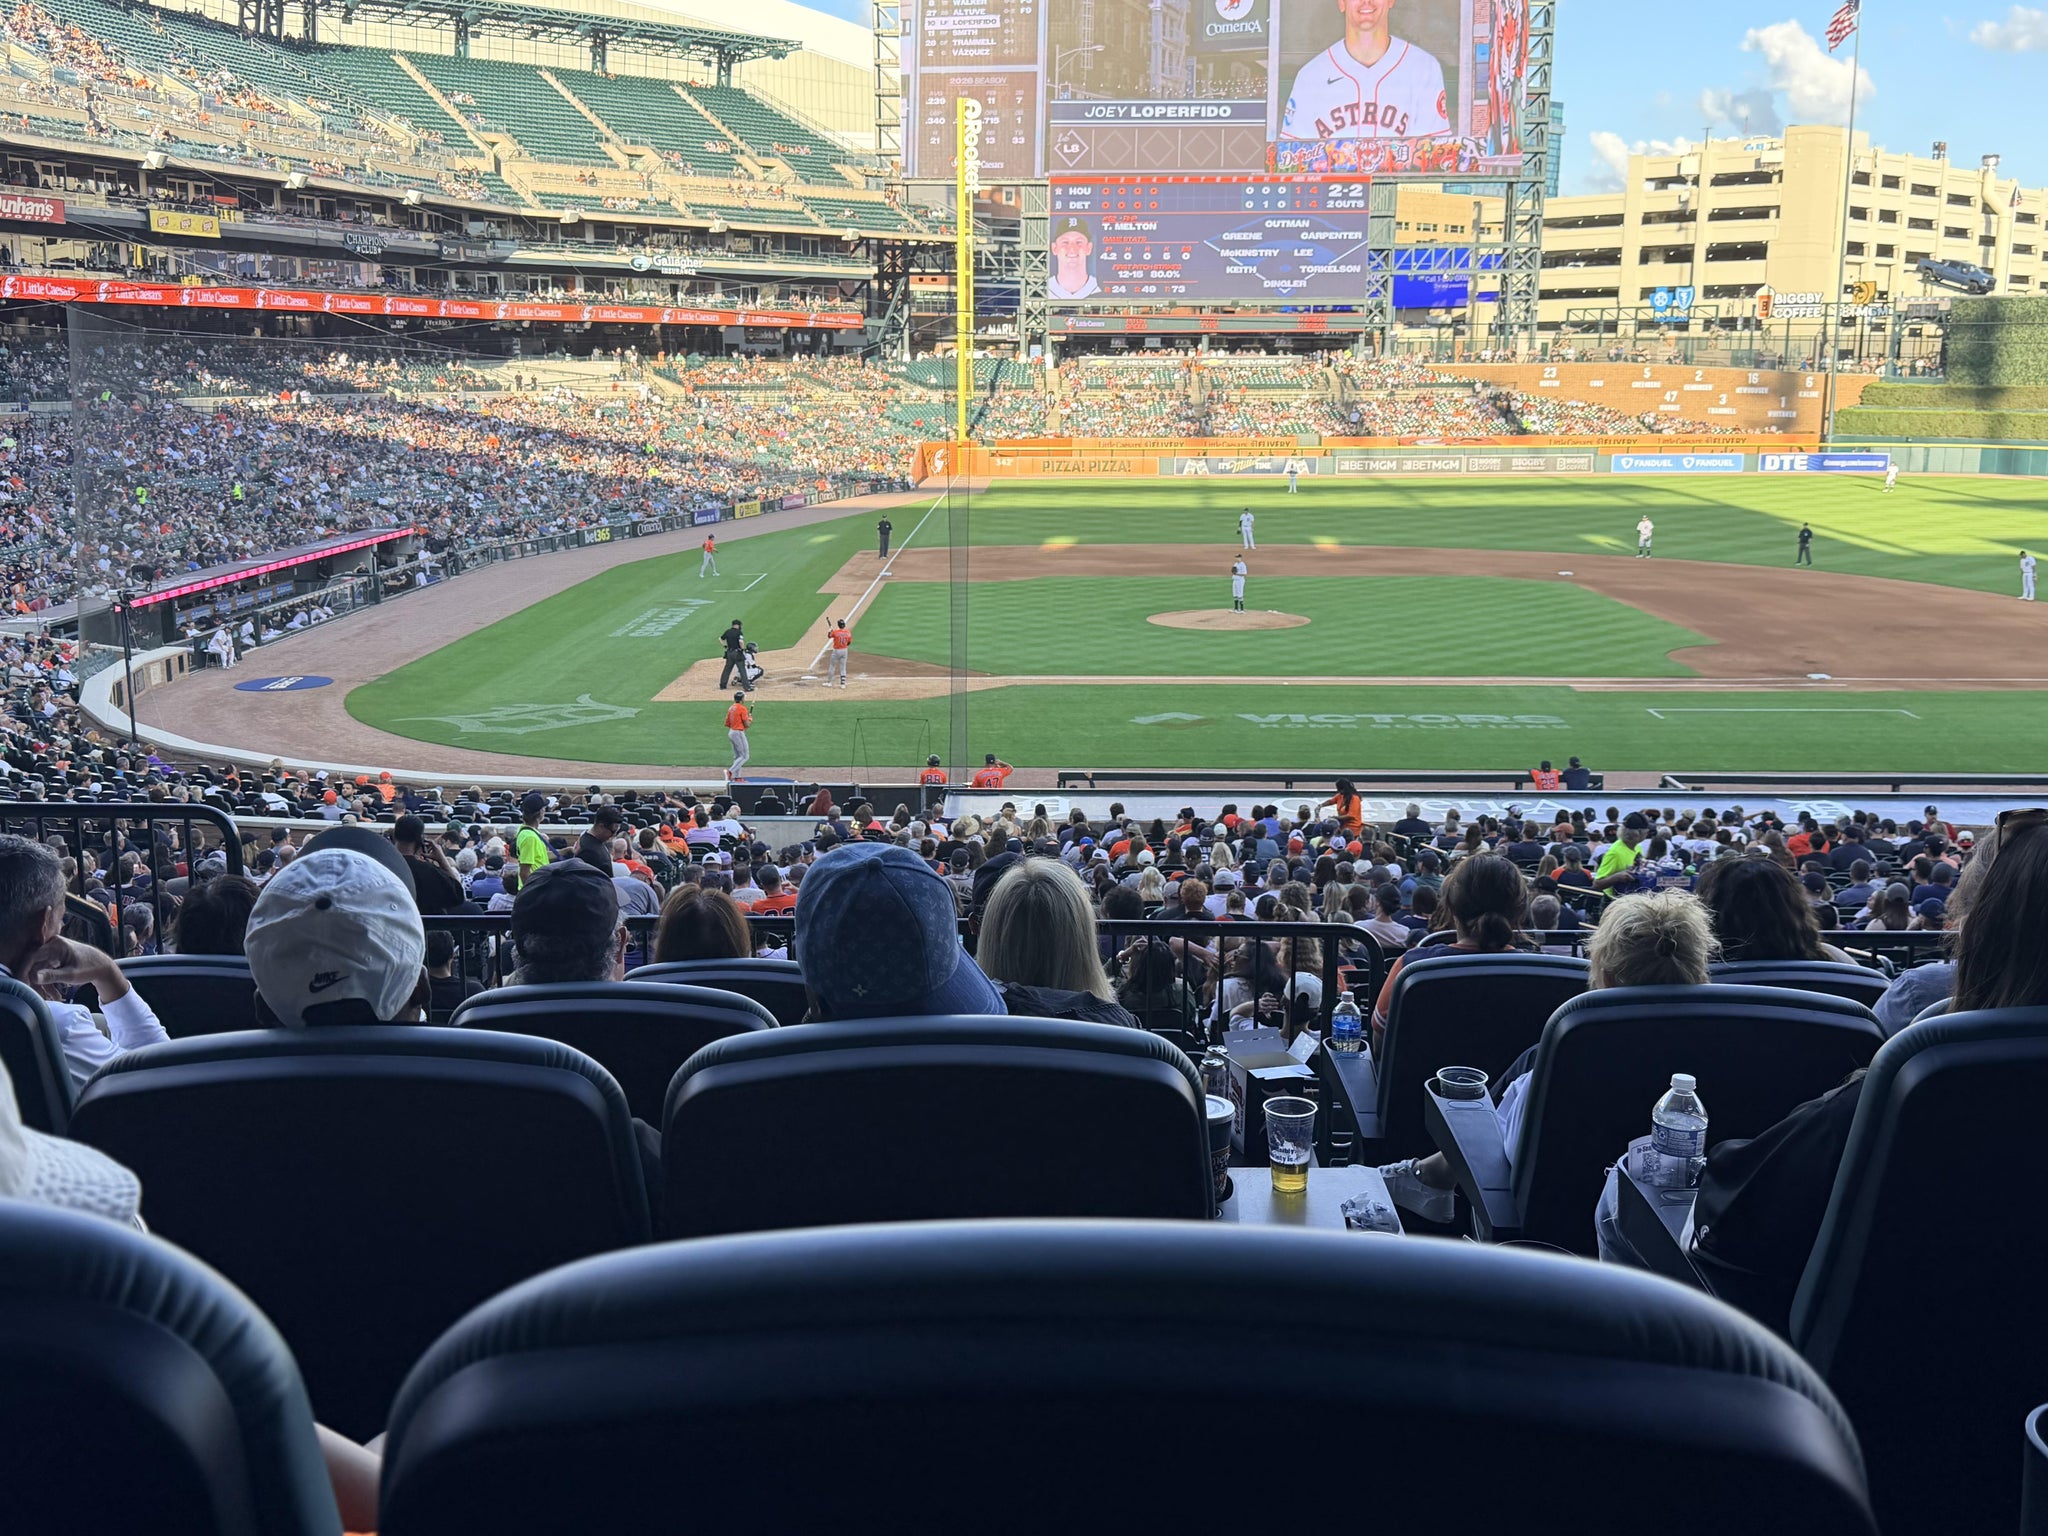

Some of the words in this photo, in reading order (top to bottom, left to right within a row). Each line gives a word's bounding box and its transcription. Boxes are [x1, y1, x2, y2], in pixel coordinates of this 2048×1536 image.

[952, 18, 997, 26] LOPERFIDO
[952, 28, 978, 36] SMITH
[952, 38, 997, 46] TRAMMELL
[1085, 106, 1128, 118] JOEY
[1131, 105, 1231, 117] LOPERFIDO
[1314, 102, 1409, 138] ASTROS
[964, 120, 982, 194] Rocket
[1280, 142, 1326, 169] Detroit
[1069, 187, 1091, 196] HOU
[1102, 187, 1110, 195] 0
[1118, 187, 1126, 195] 0
[1134, 187, 1142, 195] 0
[1149, 187, 1158, 195] 0
[1262, 186, 1270, 194] 0
[1278, 186, 1286, 194] 0
[1328, 184, 1363, 197] 2-2
[0, 197, 54, 217] unham's
[1069, 201, 1091, 210] DET
[1102, 201, 1110, 209] 0
[1118, 201, 1126, 209] 0
[1133, 201, 1142, 209] 0
[1149, 201, 1158, 209] 0
[1263, 200, 1269, 208] 1
[1335, 200, 1364, 208] OUTS
[1102, 223, 1112, 231] T.
[1114, 223, 1157, 231] MELTON
[1265, 219, 1310, 228] OUTMAN
[346, 233, 389, 248] CHAMPIONS
[1222, 232, 1263, 240] GREENE
[1301, 232, 1362, 240] CARPENTER
[361, 245, 379, 254] CLUB
[1220, 249, 1280, 257] McKINSTRY
[1294, 249, 1314, 257] LEE
[653, 255, 704, 268] Gallagher
[1226, 266, 1257, 274] KEITH
[1299, 265, 1361, 273] TORKELSON
[1118, 271, 1144, 279] 12-15
[1150, 271, 1181, 279] 80.0%
[22, 281, 45, 296] Little
[46, 282, 76, 297] Caesars
[1264, 280, 1307, 288] DINGLER
[197, 290, 214, 303] Little
[214, 292, 239, 304] Caesars
[1774, 292, 1823, 304] BIGGBY
[514, 307, 533, 317] Little
[533, 308, 562, 318] Caesars
[598, 309, 617, 319] Little
[617, 310, 643, 320] Caesars
[677, 311, 694, 321] Little
[694, 312, 720, 323] Caesars
[1773, 306, 1823, 318] COFFEE
[1543, 367, 1557, 378] 23
[1643, 367, 1651, 378] 5
[1695, 370, 1703, 381] 2
[1747, 373, 1760, 384] 16
[1805, 376, 1814, 388] 6
[1664, 390, 1678, 402] 47
[1719, 393, 1728, 405] 3
[1780, 396, 1786, 408] 1
[1042, 460, 1085, 473] PIZZA!
[1089, 460, 1132, 473] PIZZA!
[1351, 460, 1397, 470] BETMGM
[1413, 460, 1459, 470] BETMGM
[1512, 458, 1546, 466] BIGGBY
[1634, 459, 1673, 467] FANDUEL
[1695, 459, 1735, 467] FANDUEL
[1765, 455, 1808, 471] DTE
[585, 528, 610, 543] bet365
[1236, 713, 1566, 724] VICTORS
[926, 774, 941, 784] 88
[985, 778, 999, 788] 47
[314, 970, 341, 984] NIKE
